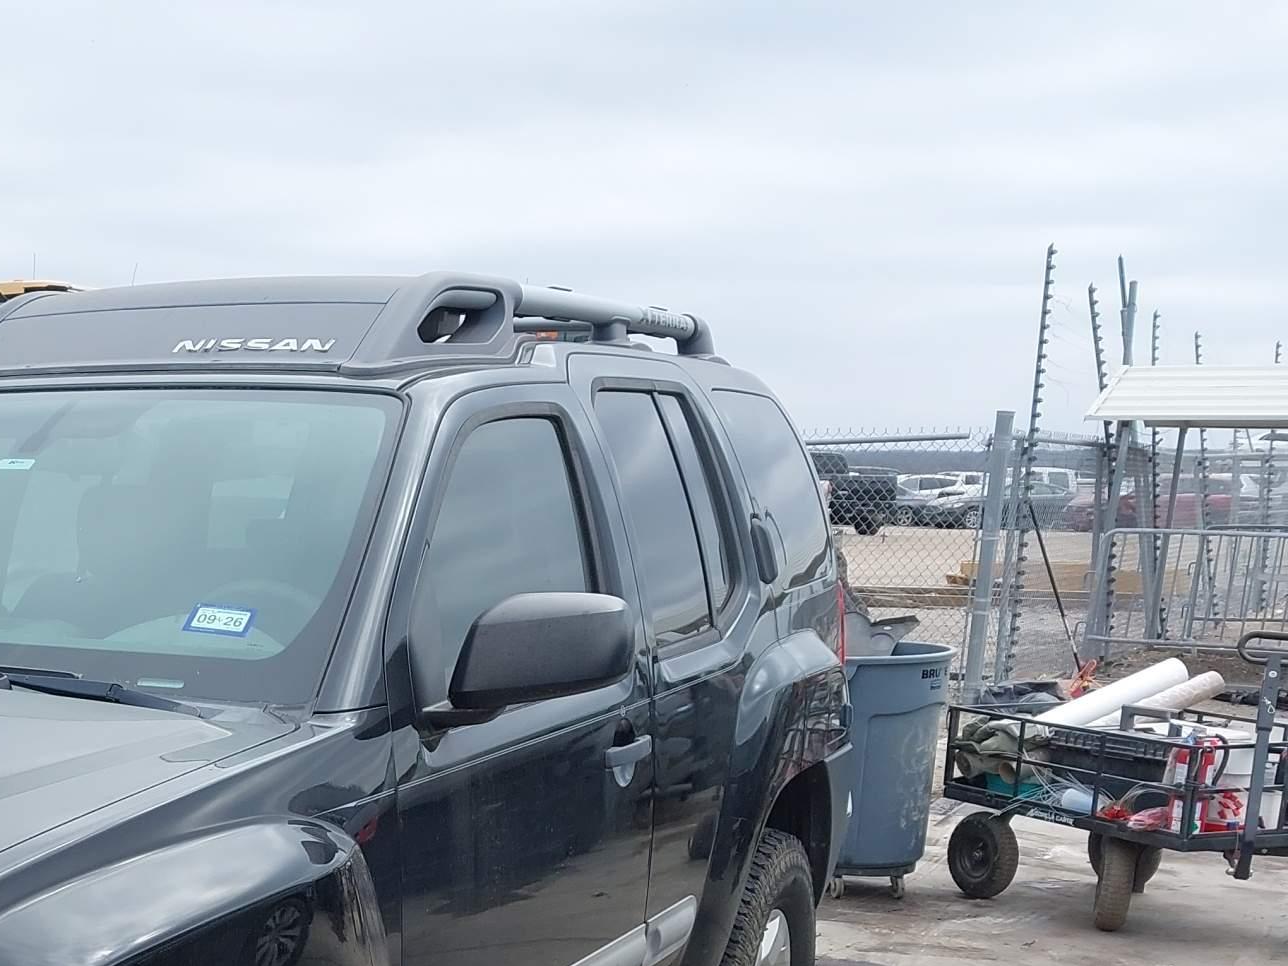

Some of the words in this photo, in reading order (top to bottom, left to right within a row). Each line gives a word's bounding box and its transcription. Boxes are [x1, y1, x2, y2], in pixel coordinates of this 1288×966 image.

[172, 338, 336, 353] NISSAN
[196, 613, 217, 625] 09
[223, 615, 244, 628] 26
